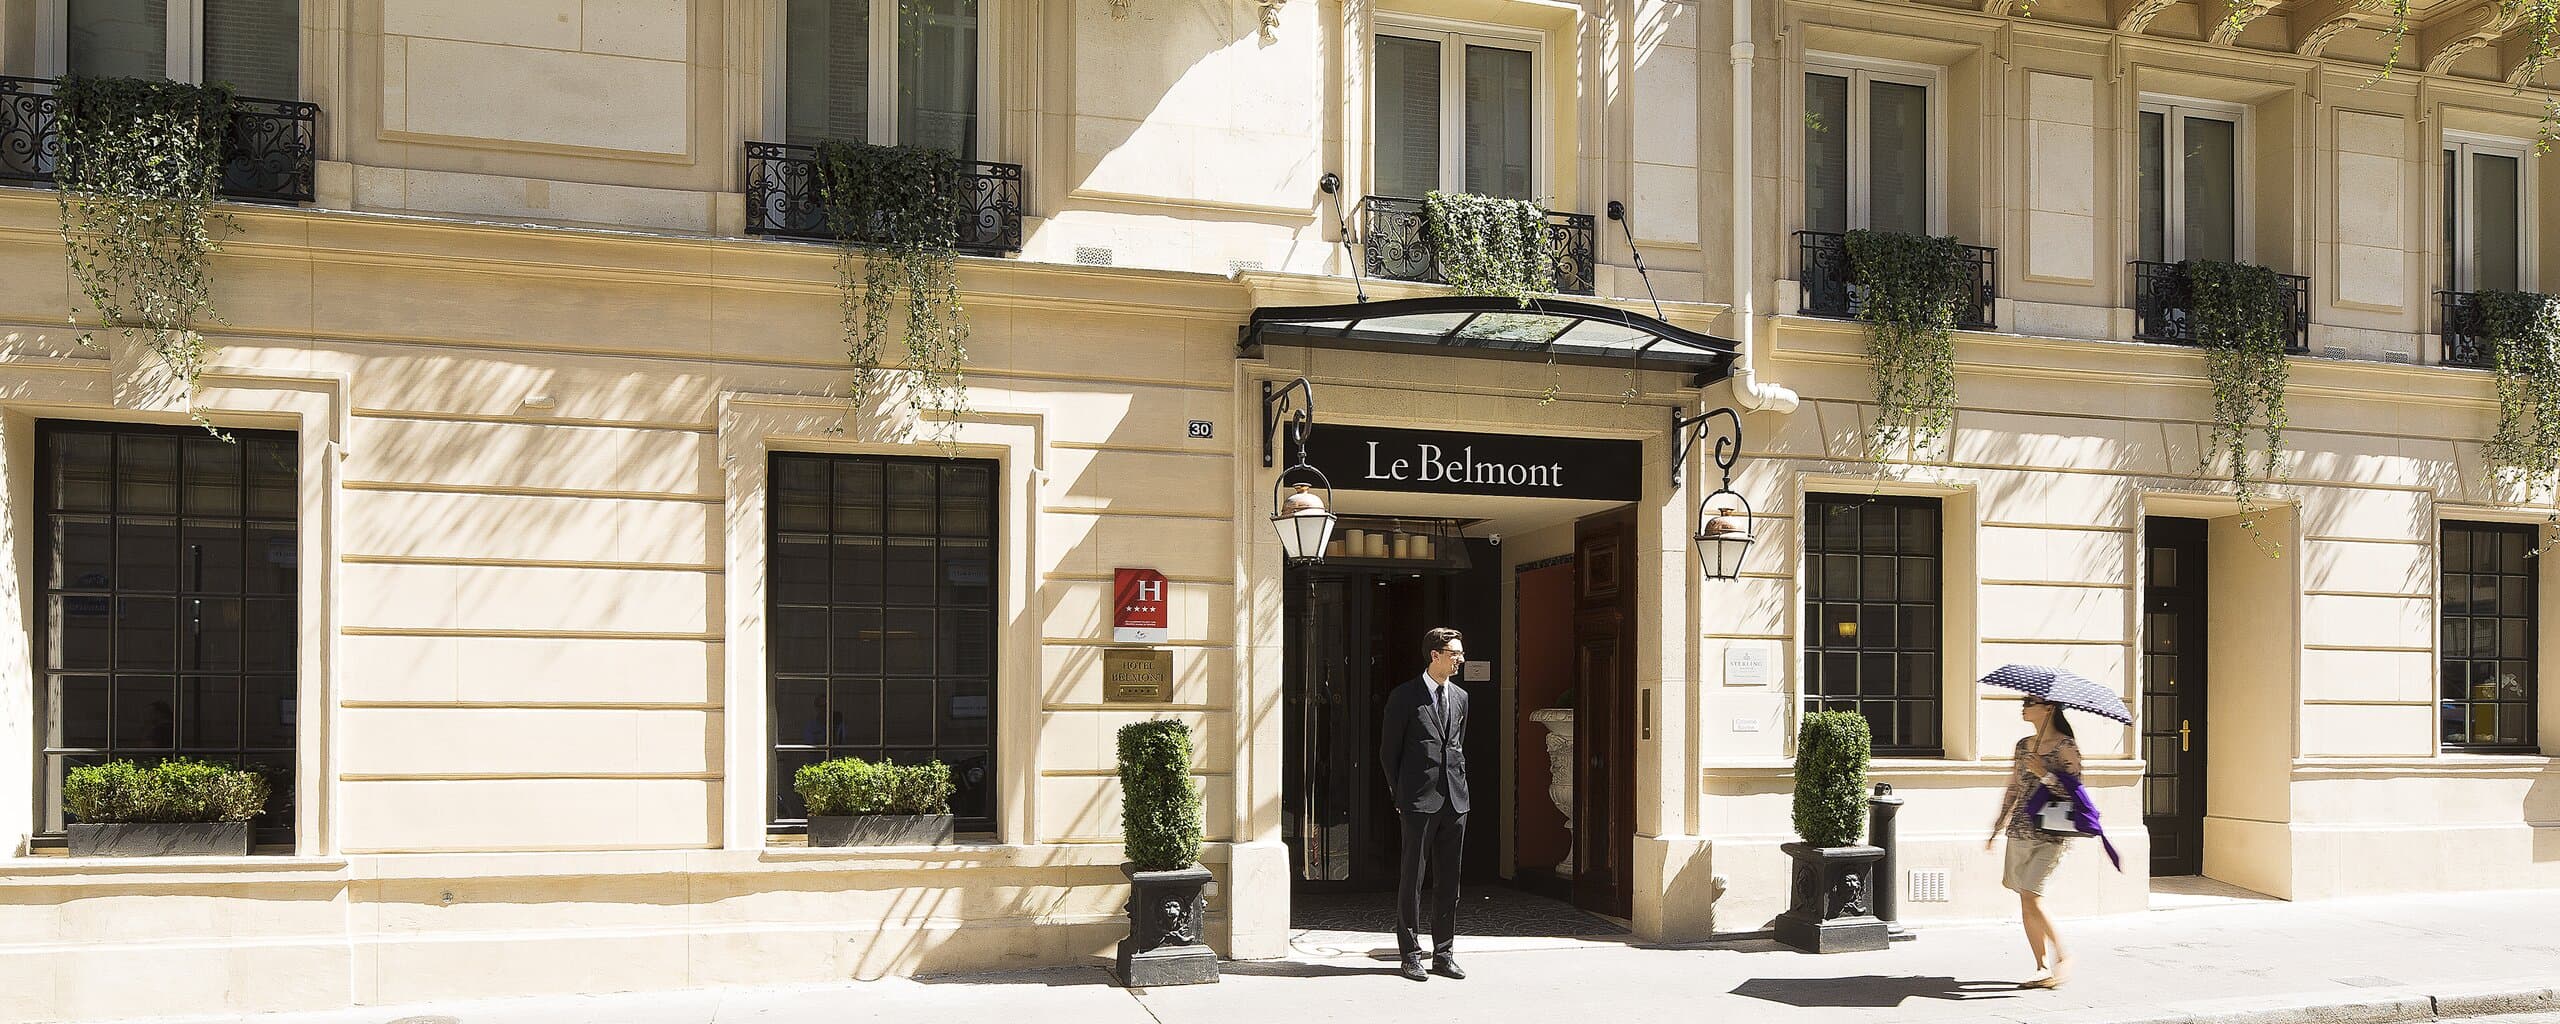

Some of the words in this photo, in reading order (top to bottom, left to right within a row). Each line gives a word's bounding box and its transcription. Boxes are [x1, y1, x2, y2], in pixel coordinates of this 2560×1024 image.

[1191, 423, 1209, 435] 30
[1364, 441, 1409, 480] Le
[1416, 443, 1564, 487] Belmont
[1137, 580, 1163, 601] H
[1112, 672, 1165, 682] BELMONT
